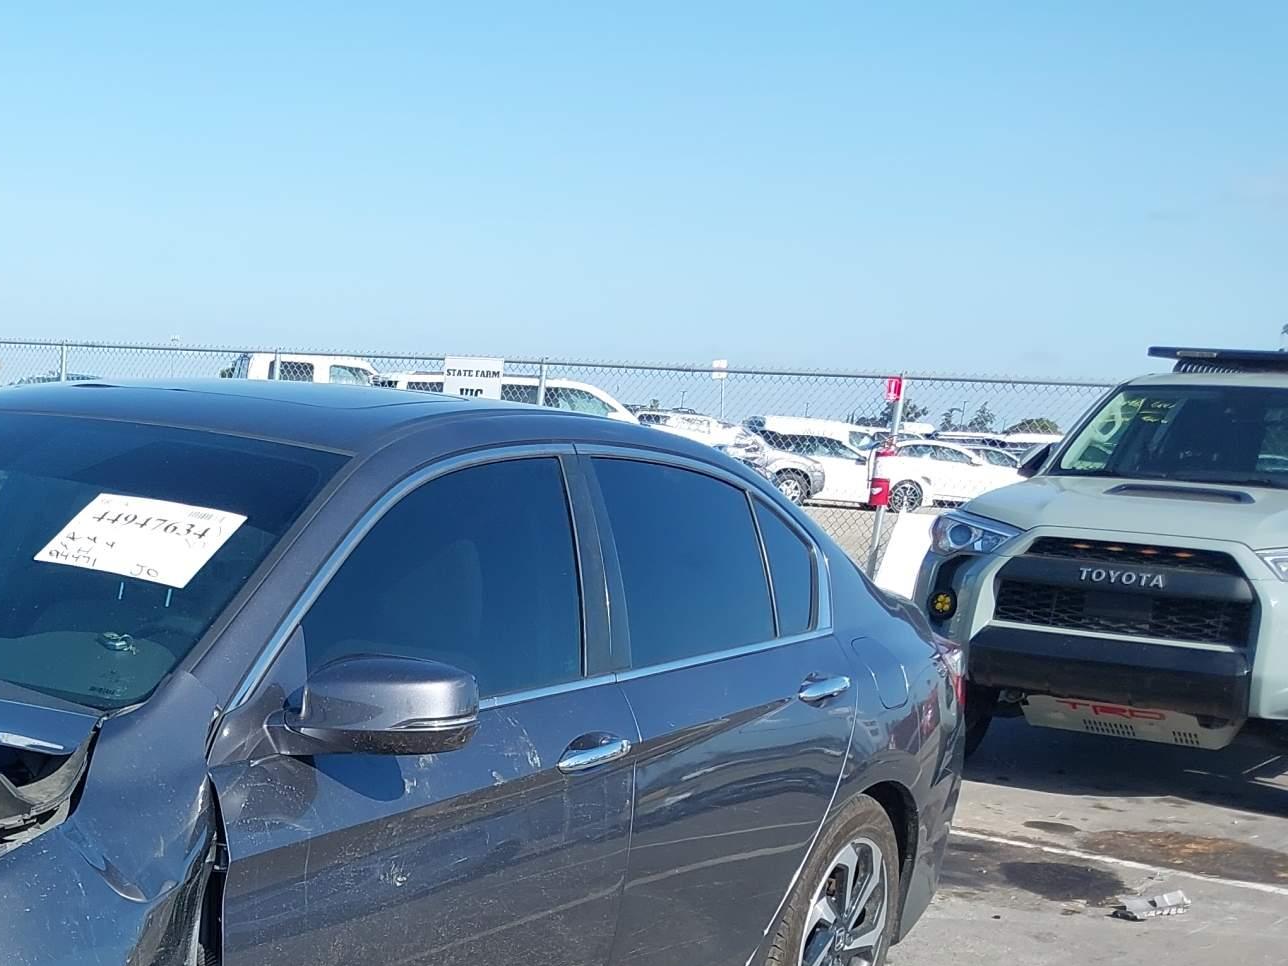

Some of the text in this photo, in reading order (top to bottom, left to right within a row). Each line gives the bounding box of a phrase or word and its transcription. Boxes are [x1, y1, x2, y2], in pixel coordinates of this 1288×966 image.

[446, 368, 473, 377] STATE
[475, 369, 500, 378] FARM
[92, 510, 211, 540] 44947634
[1079, 567, 1165, 588] TOYOTA
